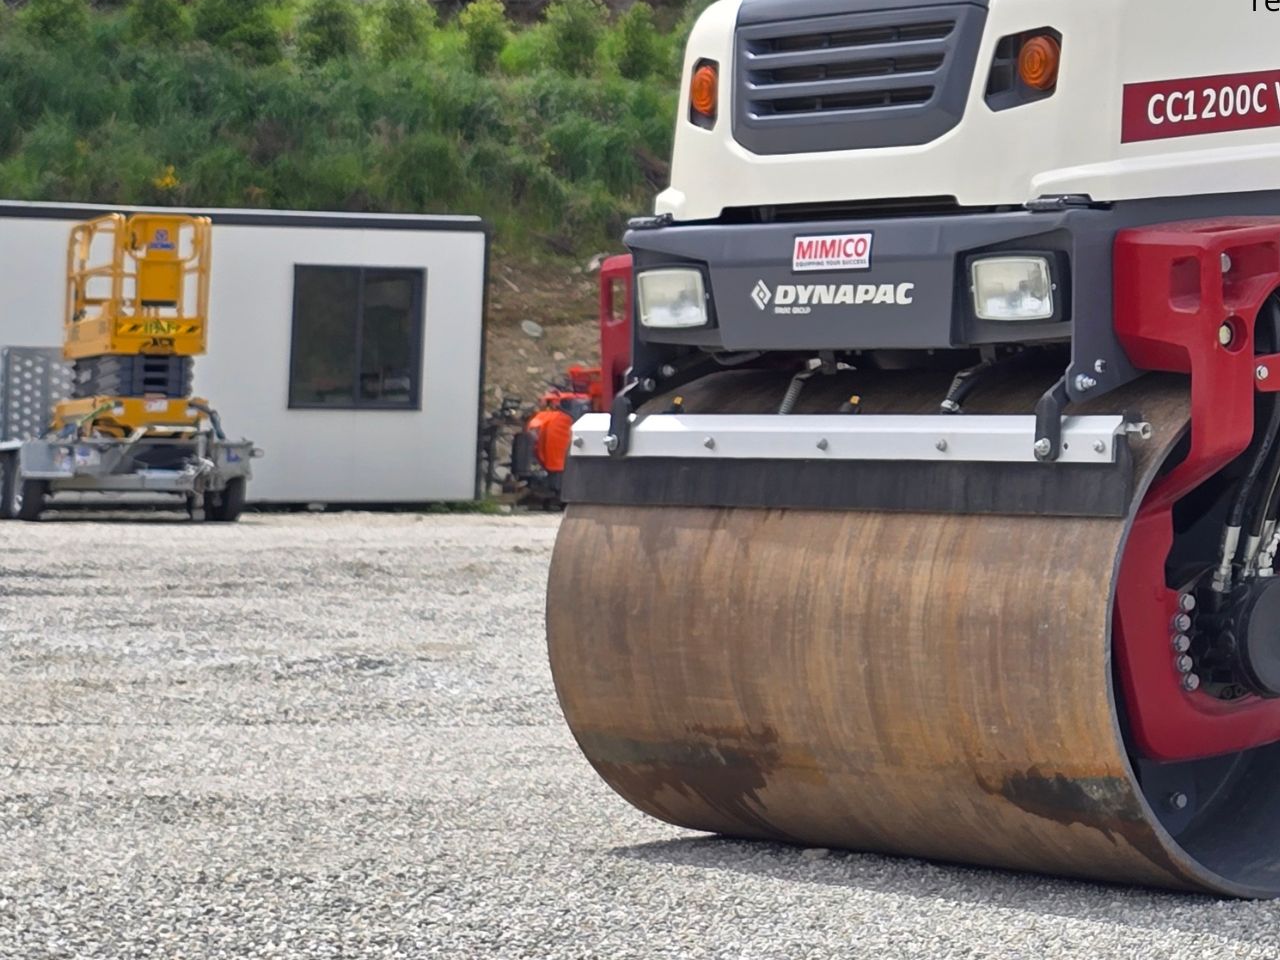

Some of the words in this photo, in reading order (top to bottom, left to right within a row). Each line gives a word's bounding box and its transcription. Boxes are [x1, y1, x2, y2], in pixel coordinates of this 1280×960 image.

[1147, 83, 1268, 125] CC1200C
[796, 238, 867, 259] MIMICO
[774, 283, 914, 305] DYNAPAC
